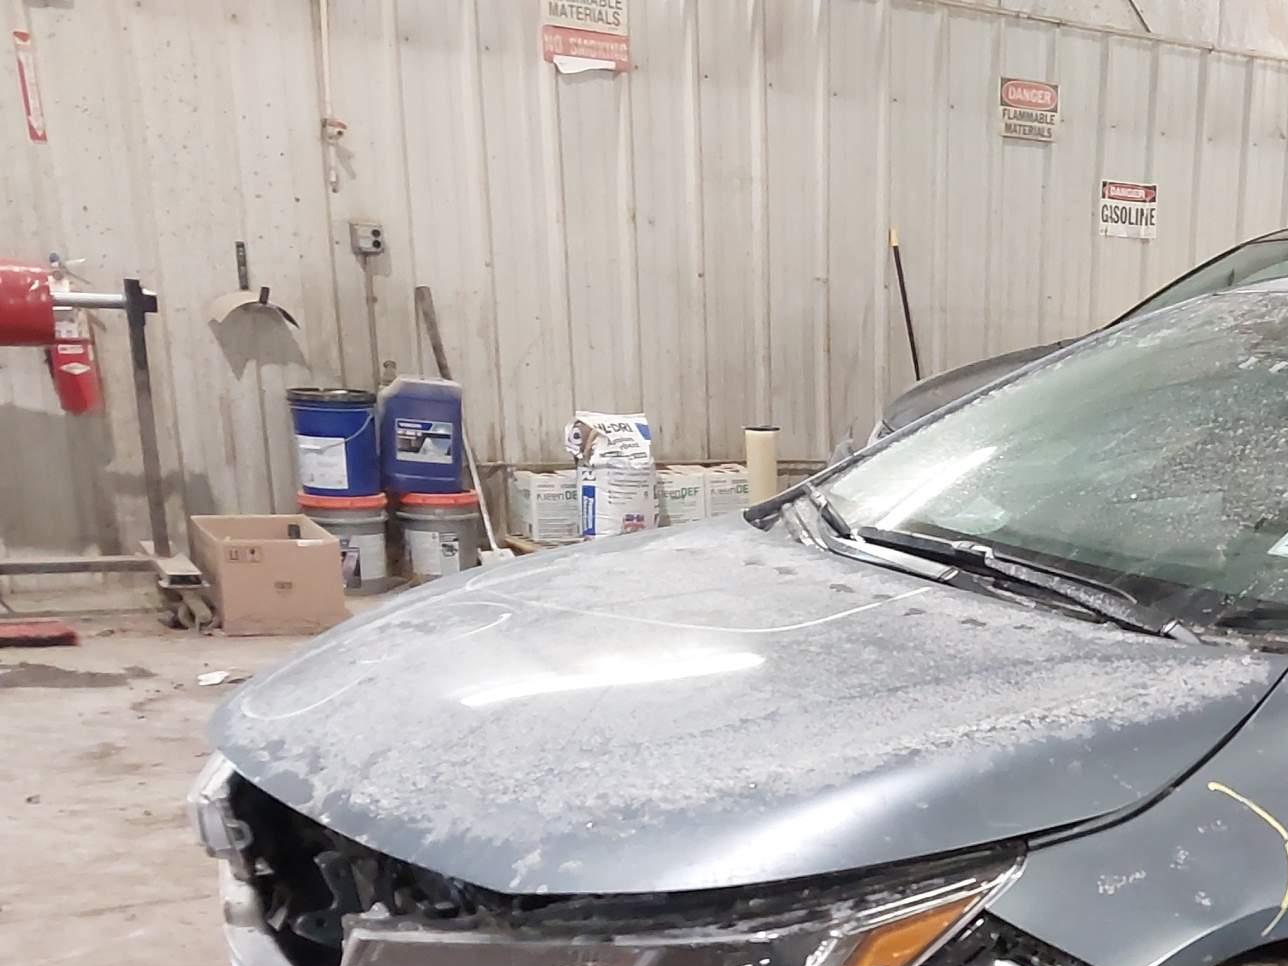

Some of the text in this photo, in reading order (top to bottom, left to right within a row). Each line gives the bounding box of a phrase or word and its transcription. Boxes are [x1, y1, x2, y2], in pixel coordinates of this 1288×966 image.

[548, 1, 621, 27] MATERIALS
[543, 33, 629, 62] NO SMOKING
[1008, 87, 1051, 105] DANGER
[1002, 108, 1055, 126] FLAMMABLE
[1005, 122, 1052, 138] MATERIALS
